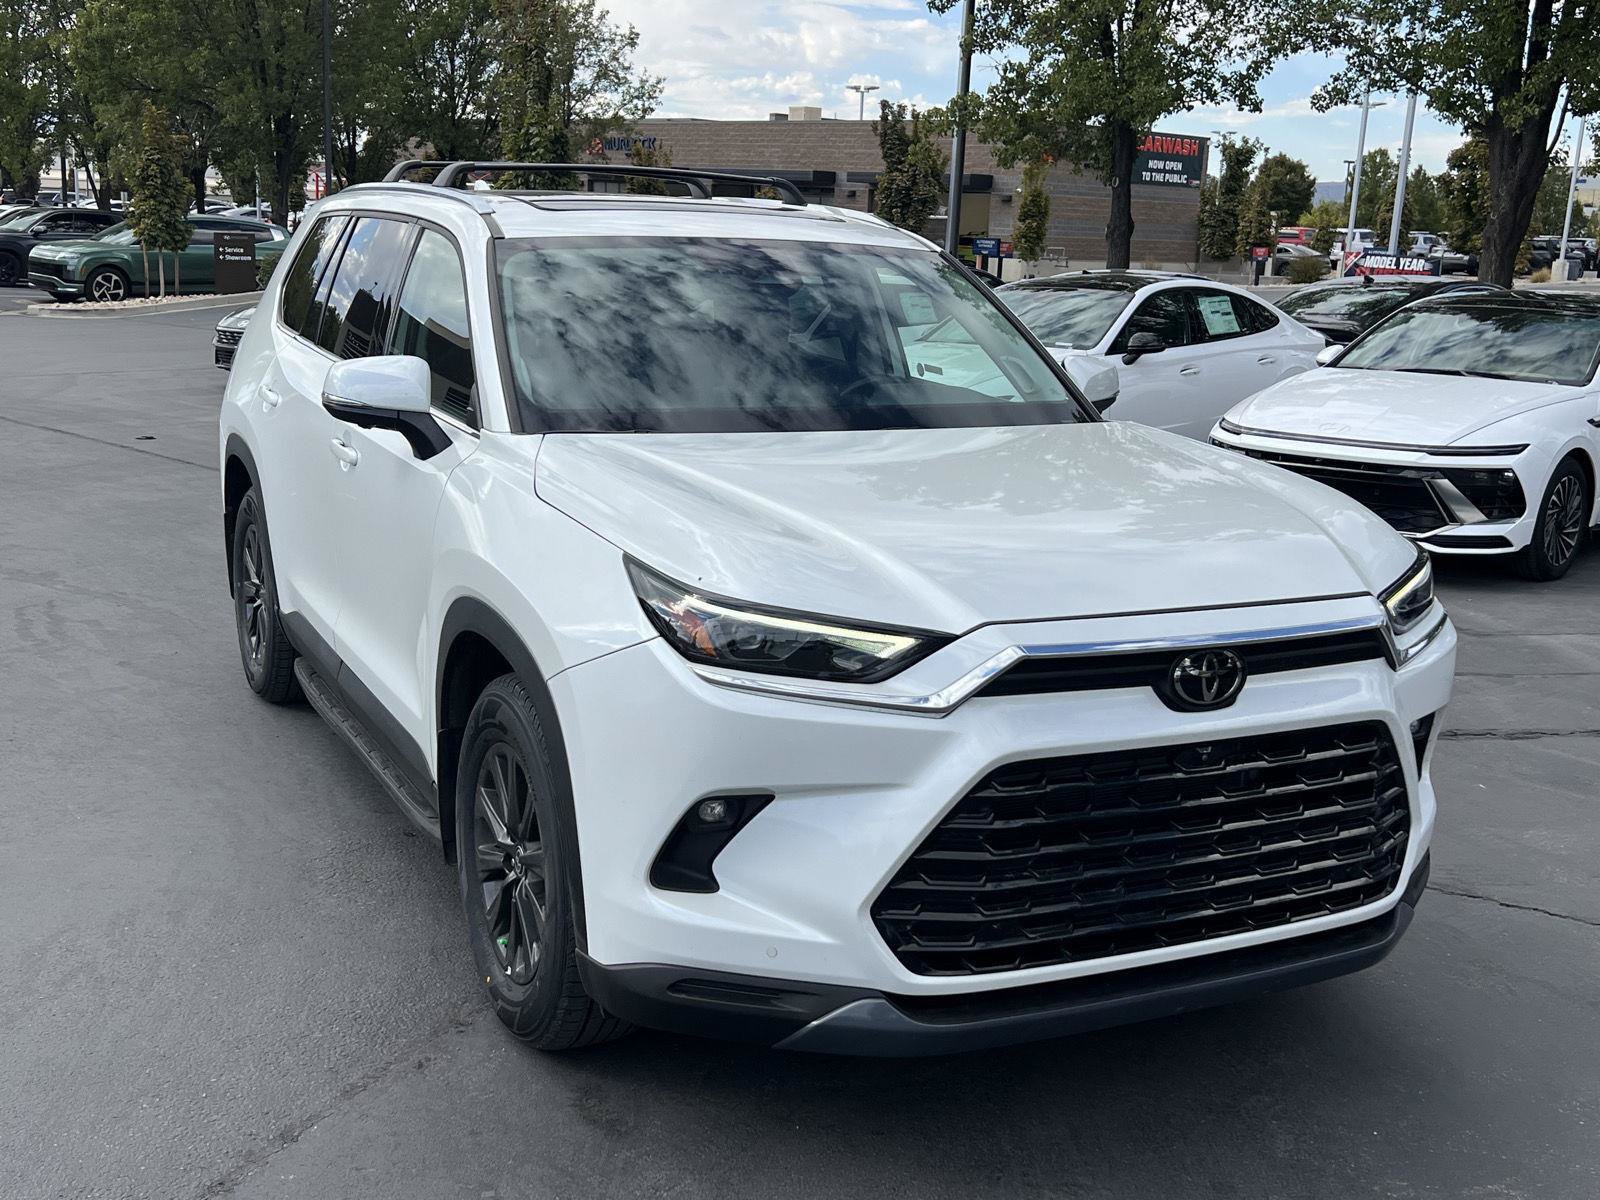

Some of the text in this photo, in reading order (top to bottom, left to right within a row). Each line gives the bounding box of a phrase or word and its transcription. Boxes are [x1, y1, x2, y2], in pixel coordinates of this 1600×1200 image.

[1148, 160, 1183, 171] NOW OPEN
[1142, 172, 1151, 181] TO
[1152, 172, 1164, 182] THE
[1165, 173, 1188, 183] PUBLIC
[1364, 255, 1397, 270] MODEL
[1399, 257, 1426, 271] YEAR
